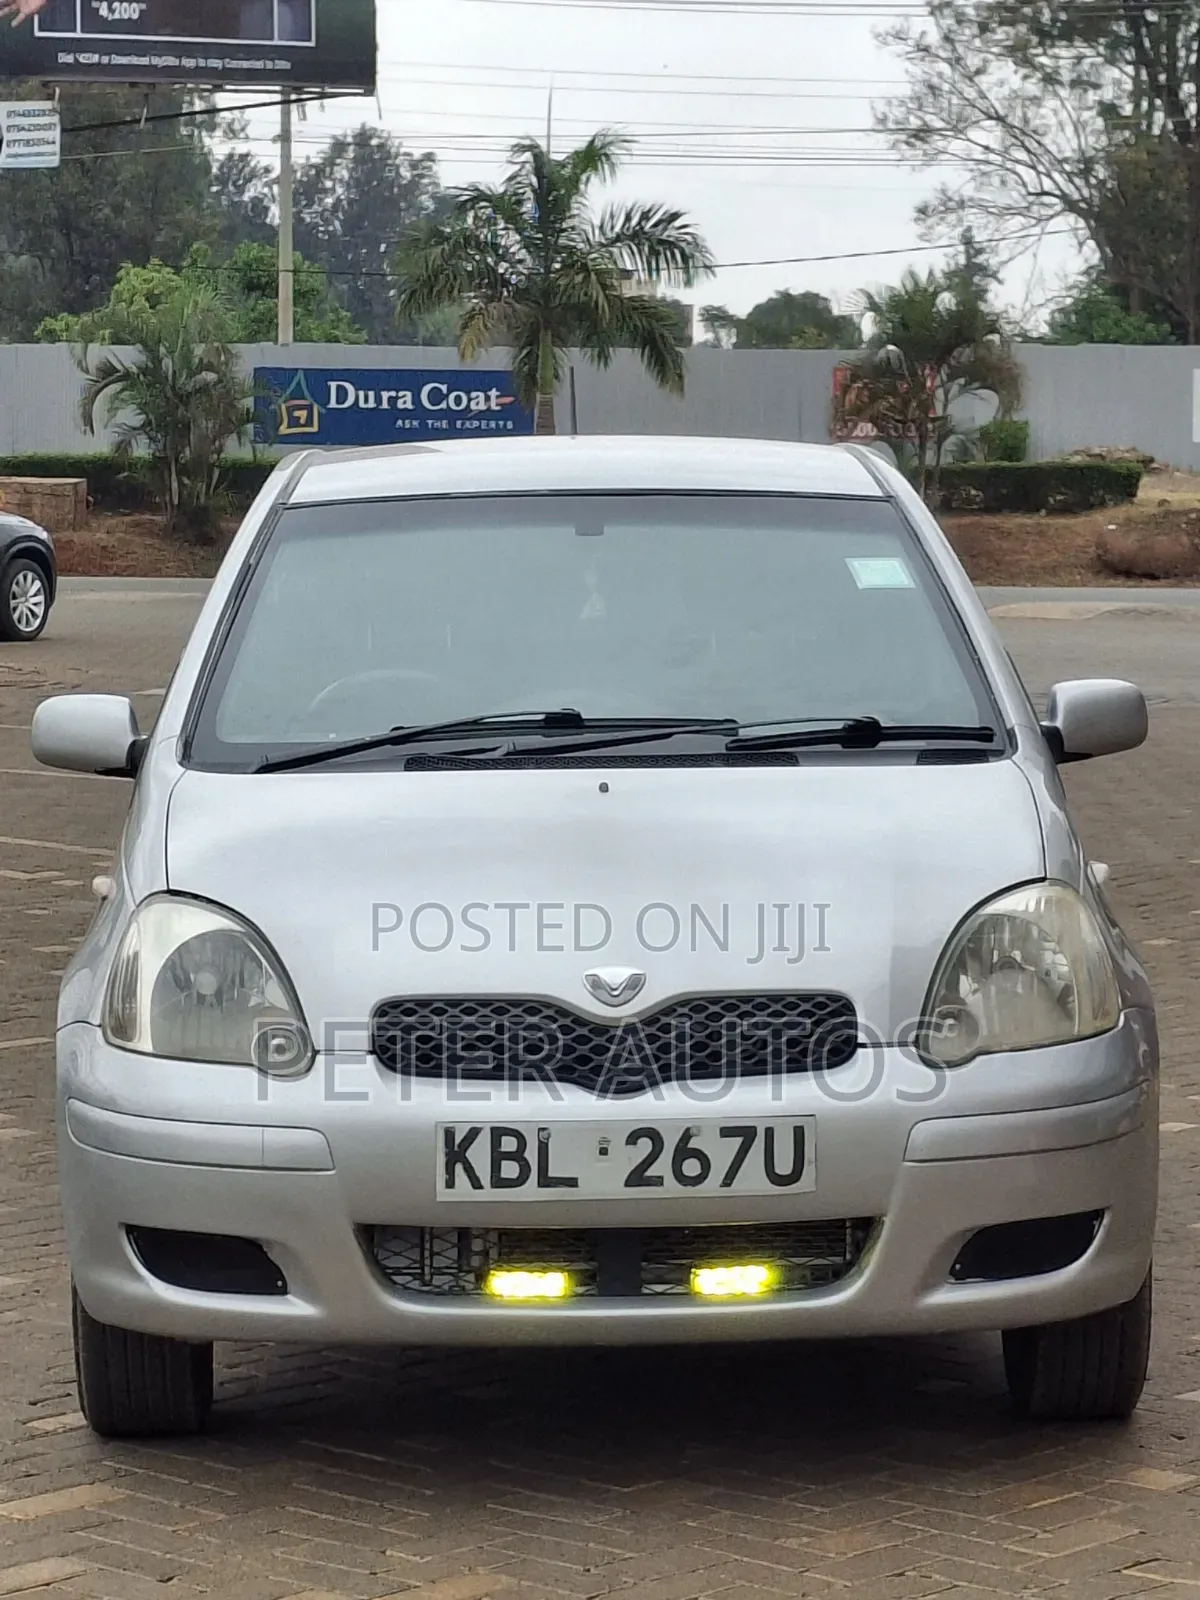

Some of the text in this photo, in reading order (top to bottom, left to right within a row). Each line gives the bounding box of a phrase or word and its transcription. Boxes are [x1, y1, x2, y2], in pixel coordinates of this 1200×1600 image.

[98, 0, 141, 20] 4,200
[327, 381, 503, 411] Dura Coat
[395, 419, 514, 430] ASK THE EXPERTS
[443, 1125, 805, 1190] KBL 267U
